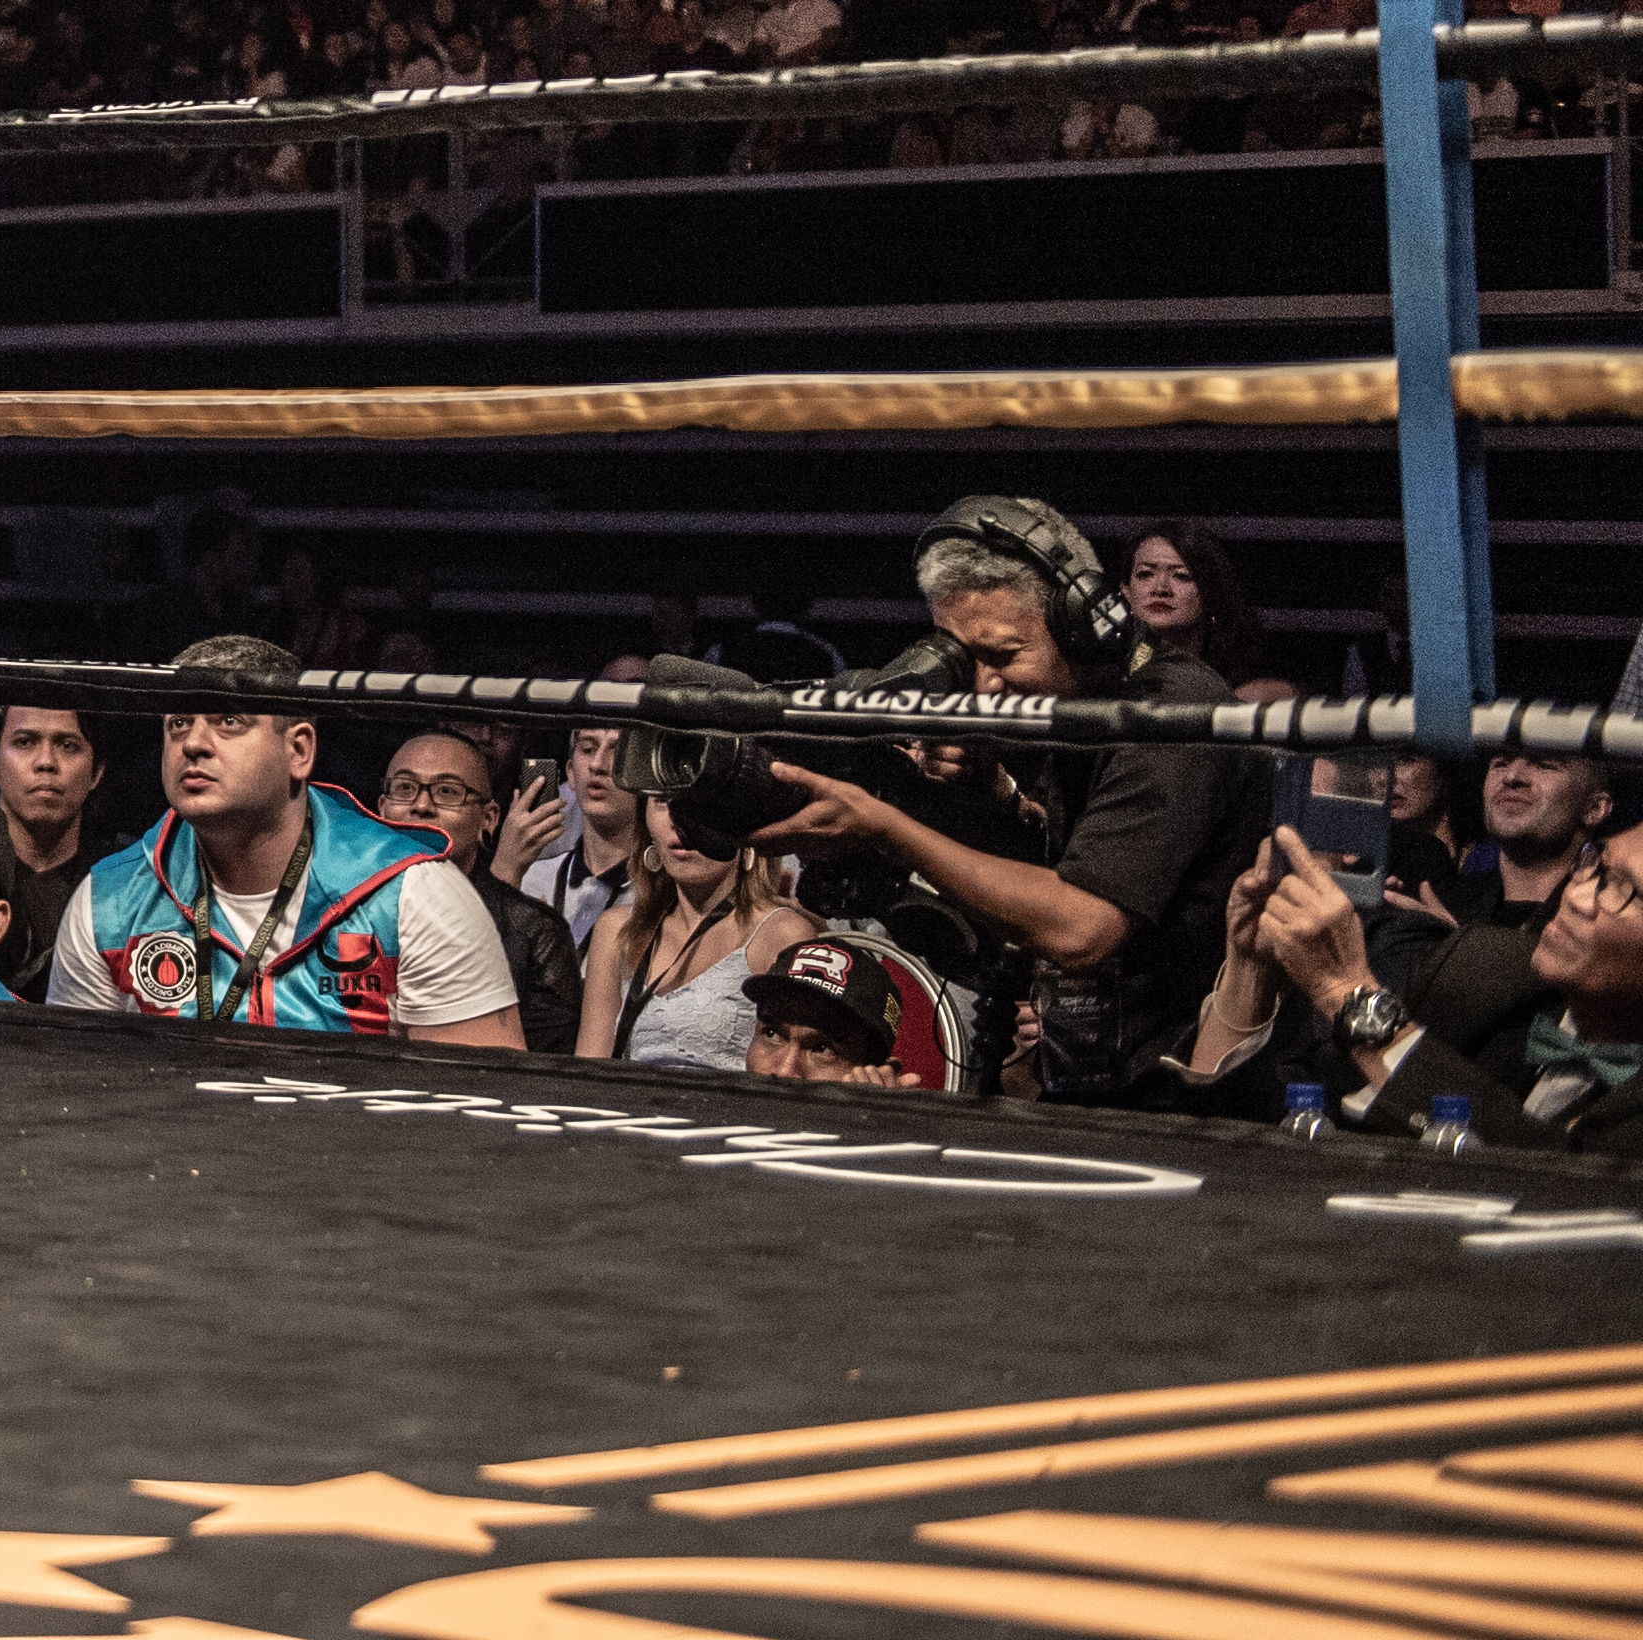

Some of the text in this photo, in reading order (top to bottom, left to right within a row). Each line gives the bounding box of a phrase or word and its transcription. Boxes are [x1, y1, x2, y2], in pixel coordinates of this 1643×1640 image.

[250, 915, 275, 957] RINGSTAR
[143, 975, 192, 997] BOXING GYM
[318, 973, 381, 995] BUKA
